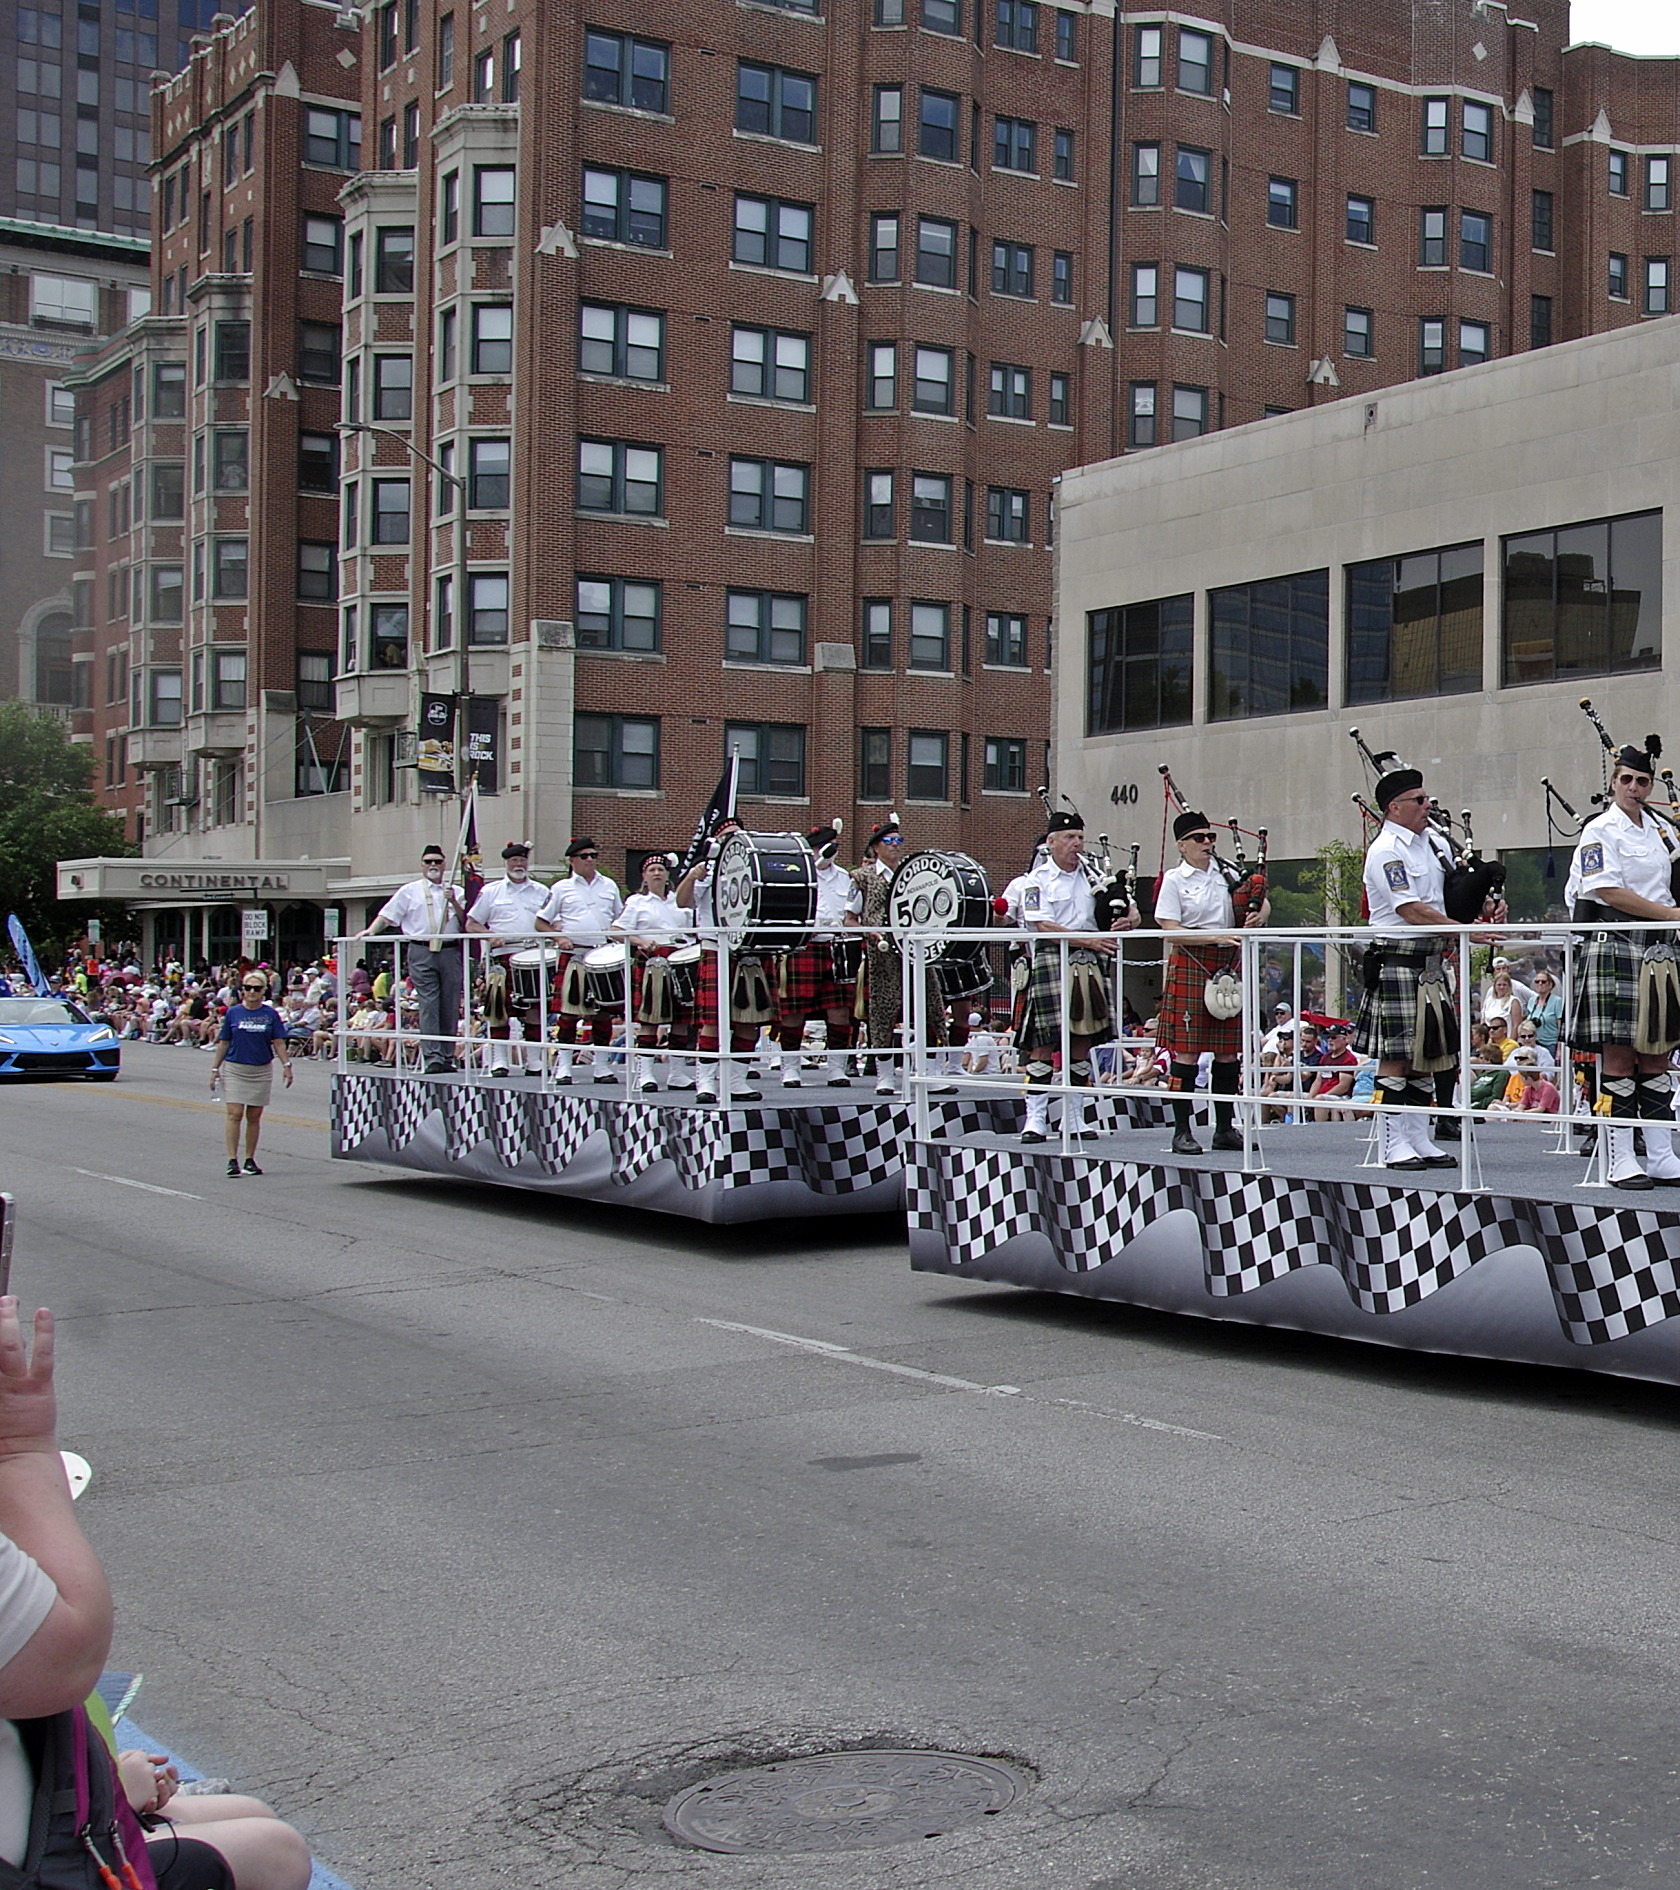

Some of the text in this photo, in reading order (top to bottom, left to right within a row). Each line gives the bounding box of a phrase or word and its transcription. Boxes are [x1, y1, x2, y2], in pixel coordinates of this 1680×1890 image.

[470, 733, 491, 743] THIS
[1110, 784, 1138, 805] 440
[141, 874, 288, 889] CONTINENTAL
[896, 858, 949, 893] GORDON
[721, 874, 751, 911] 500
[907, 879, 939, 895] INDIANAPOLIS
[896, 886, 953, 928] 500
